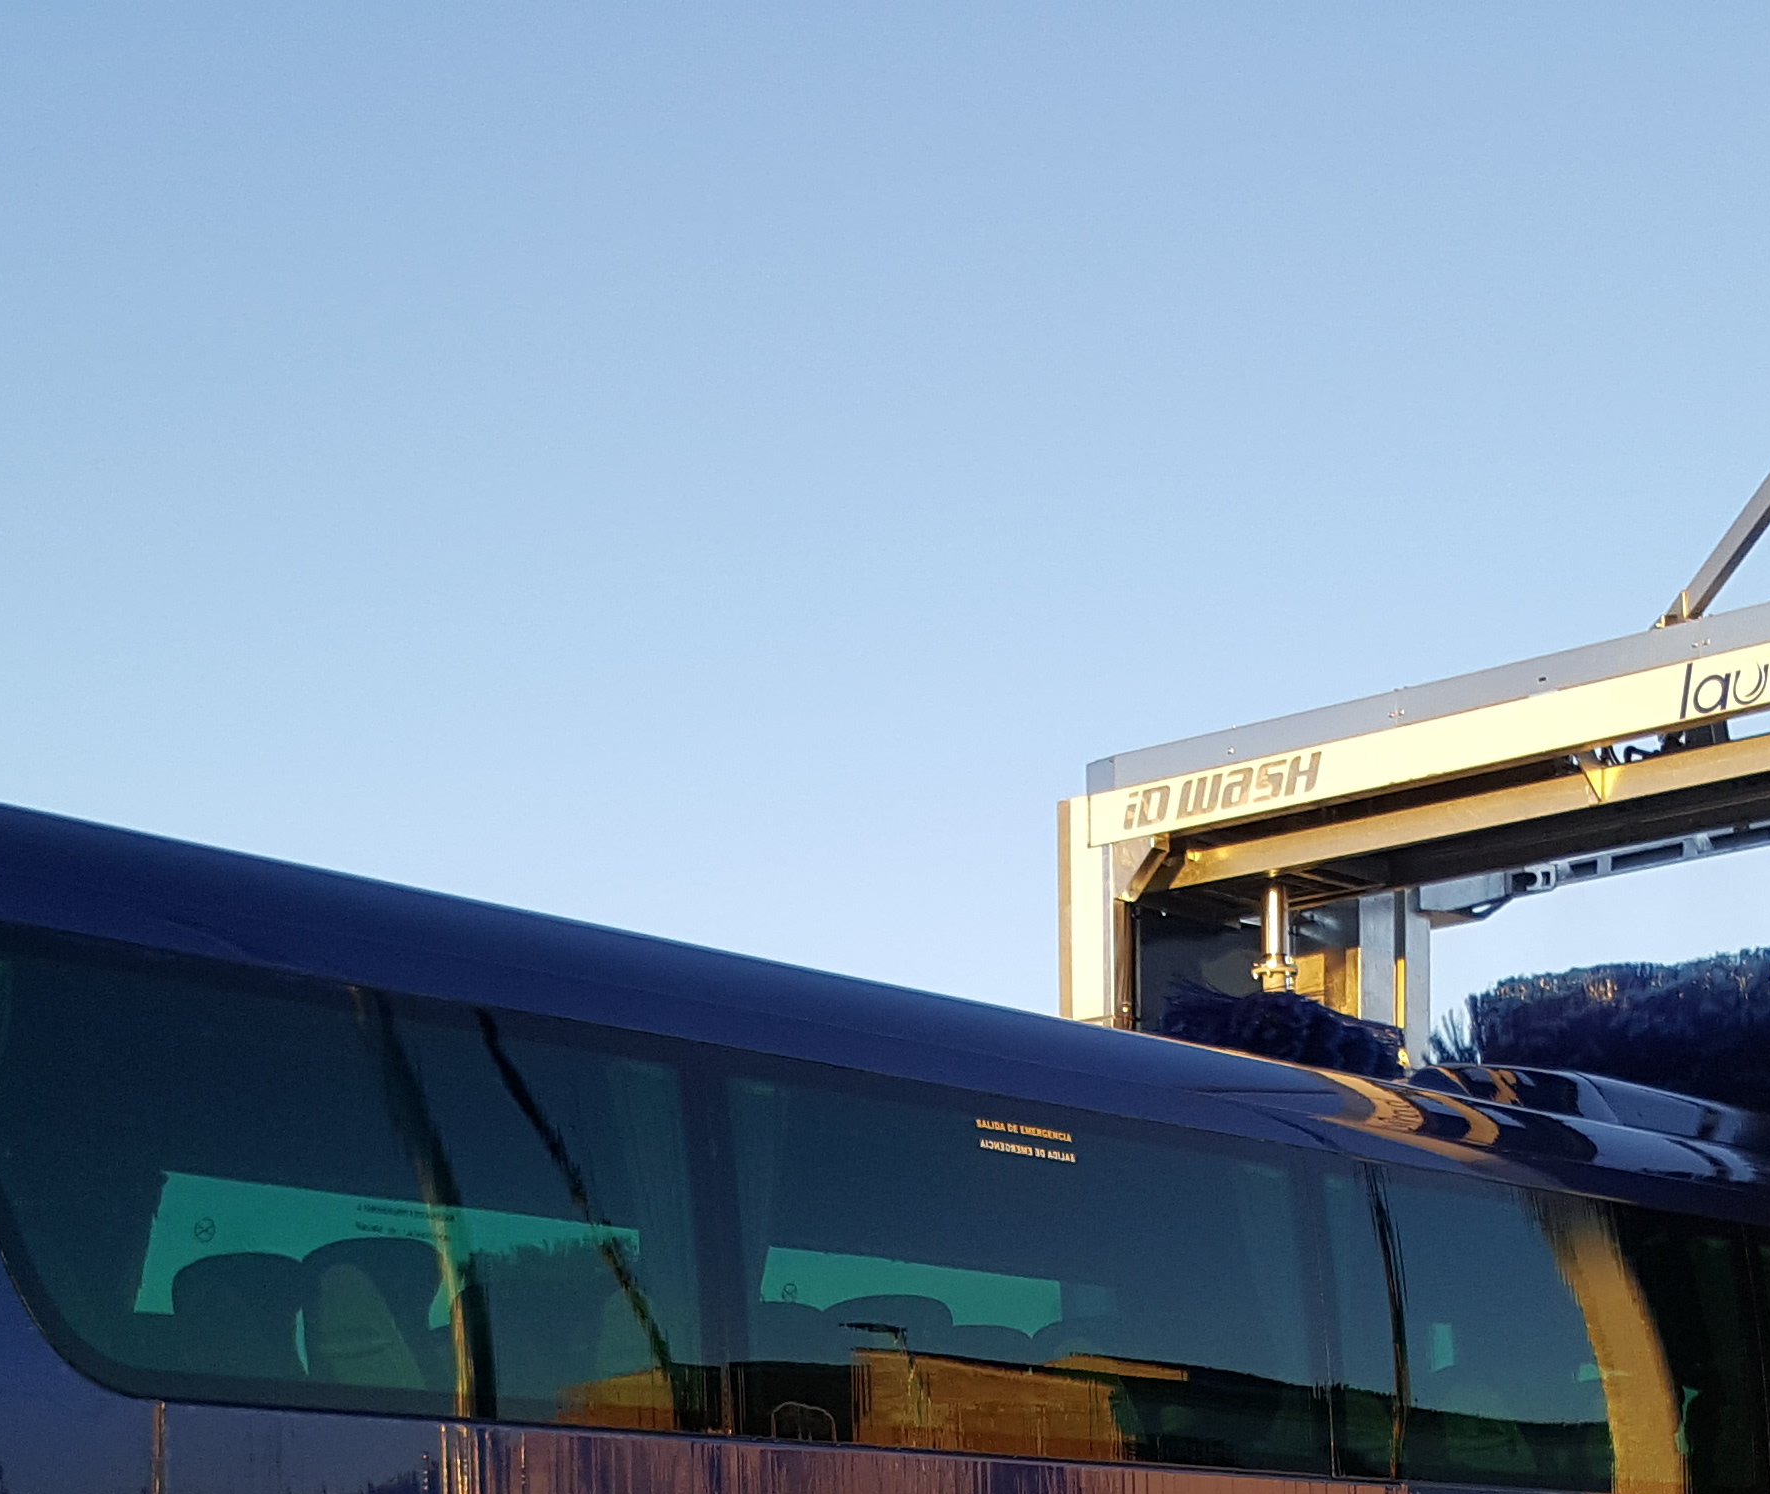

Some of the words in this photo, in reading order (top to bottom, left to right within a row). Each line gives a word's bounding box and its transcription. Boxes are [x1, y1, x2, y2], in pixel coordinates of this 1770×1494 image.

[975, 1118, 1006, 1132] SALIDA
[1007, 1122, 1019, 1134] DE
[1019, 1125, 1072, 1143] EMERGENCIA
